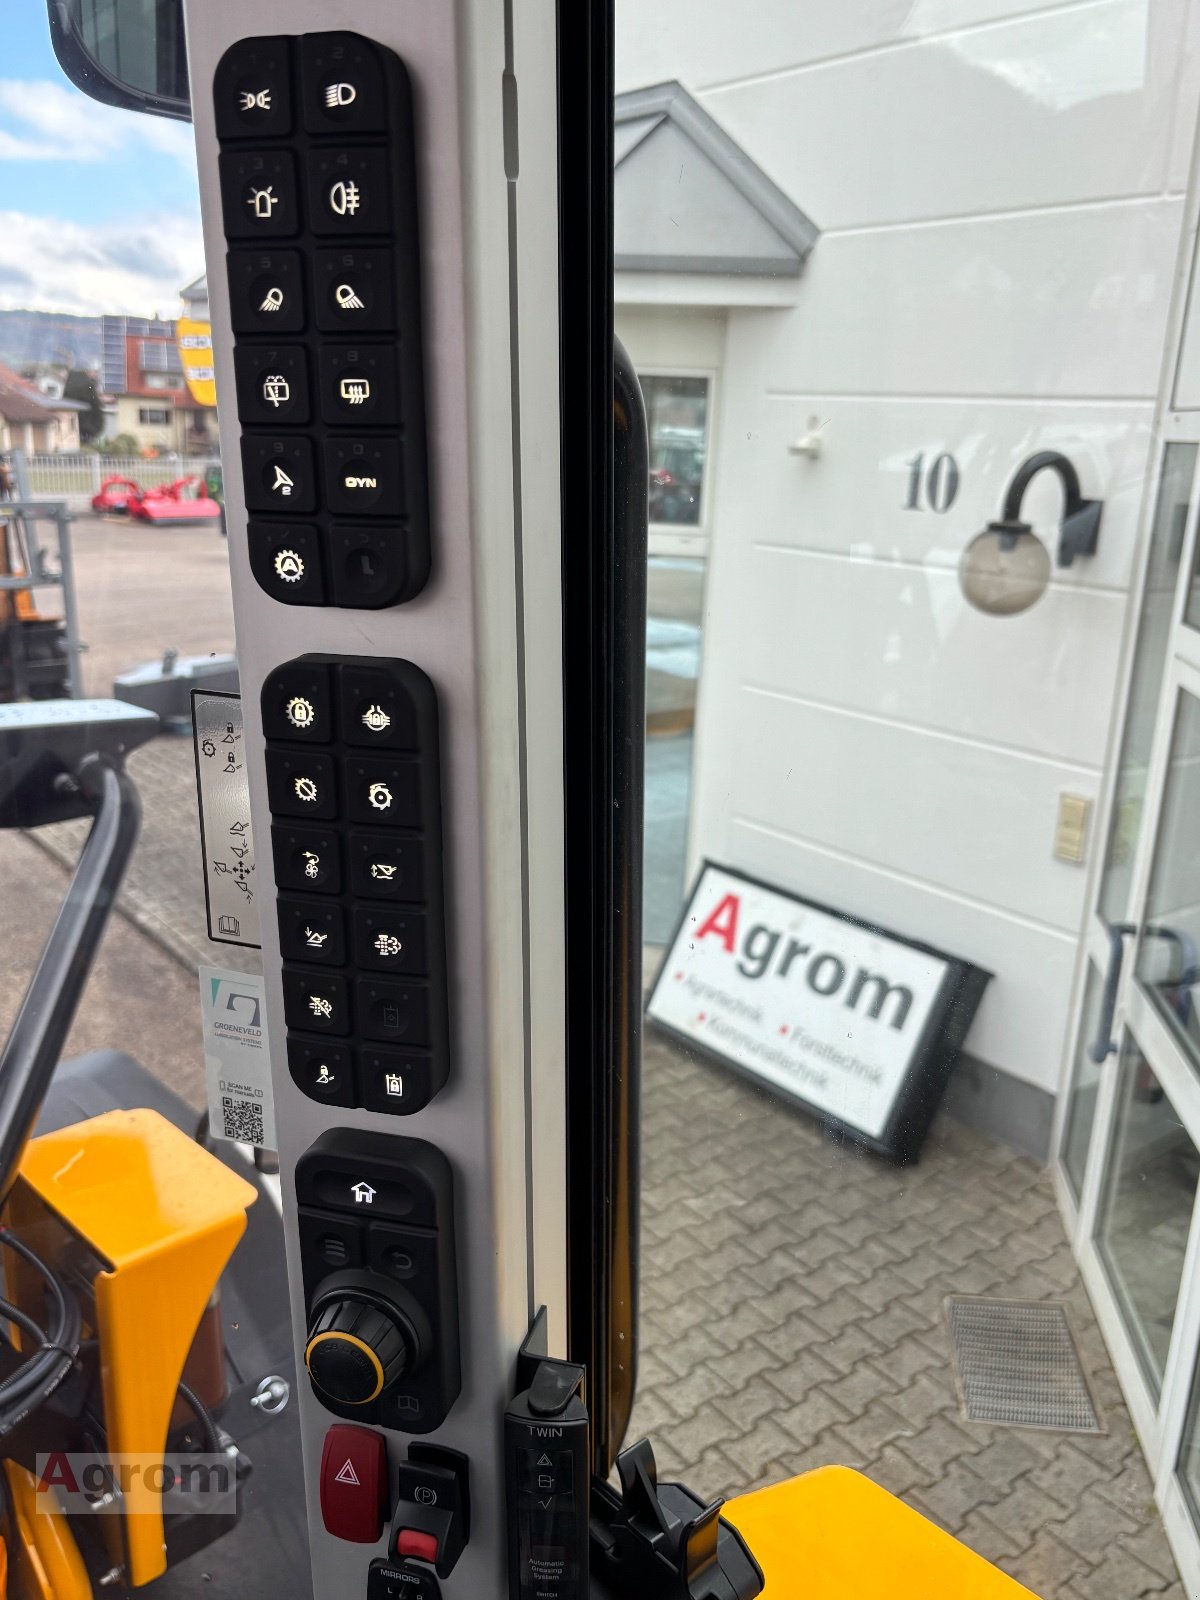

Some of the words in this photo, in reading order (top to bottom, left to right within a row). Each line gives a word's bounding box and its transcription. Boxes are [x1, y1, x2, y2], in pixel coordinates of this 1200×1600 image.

[345, 477, 377, 488] DYN
[901, 450, 960, 514] 10
[283, 559, 298, 571] A
[695, 890, 915, 1031] Agrom
[214, 1021, 262, 1036] GROENEVELD
[227, 1081, 243, 1090] SCAN
[527, 1425, 563, 1437] TWIN
[528, 1558, 565, 1567] Automatic
[531, 1565, 563, 1574] Greasing
[380, 1568, 421, 1585] MIRRORS
[387, 1586, 393, 1594] L
